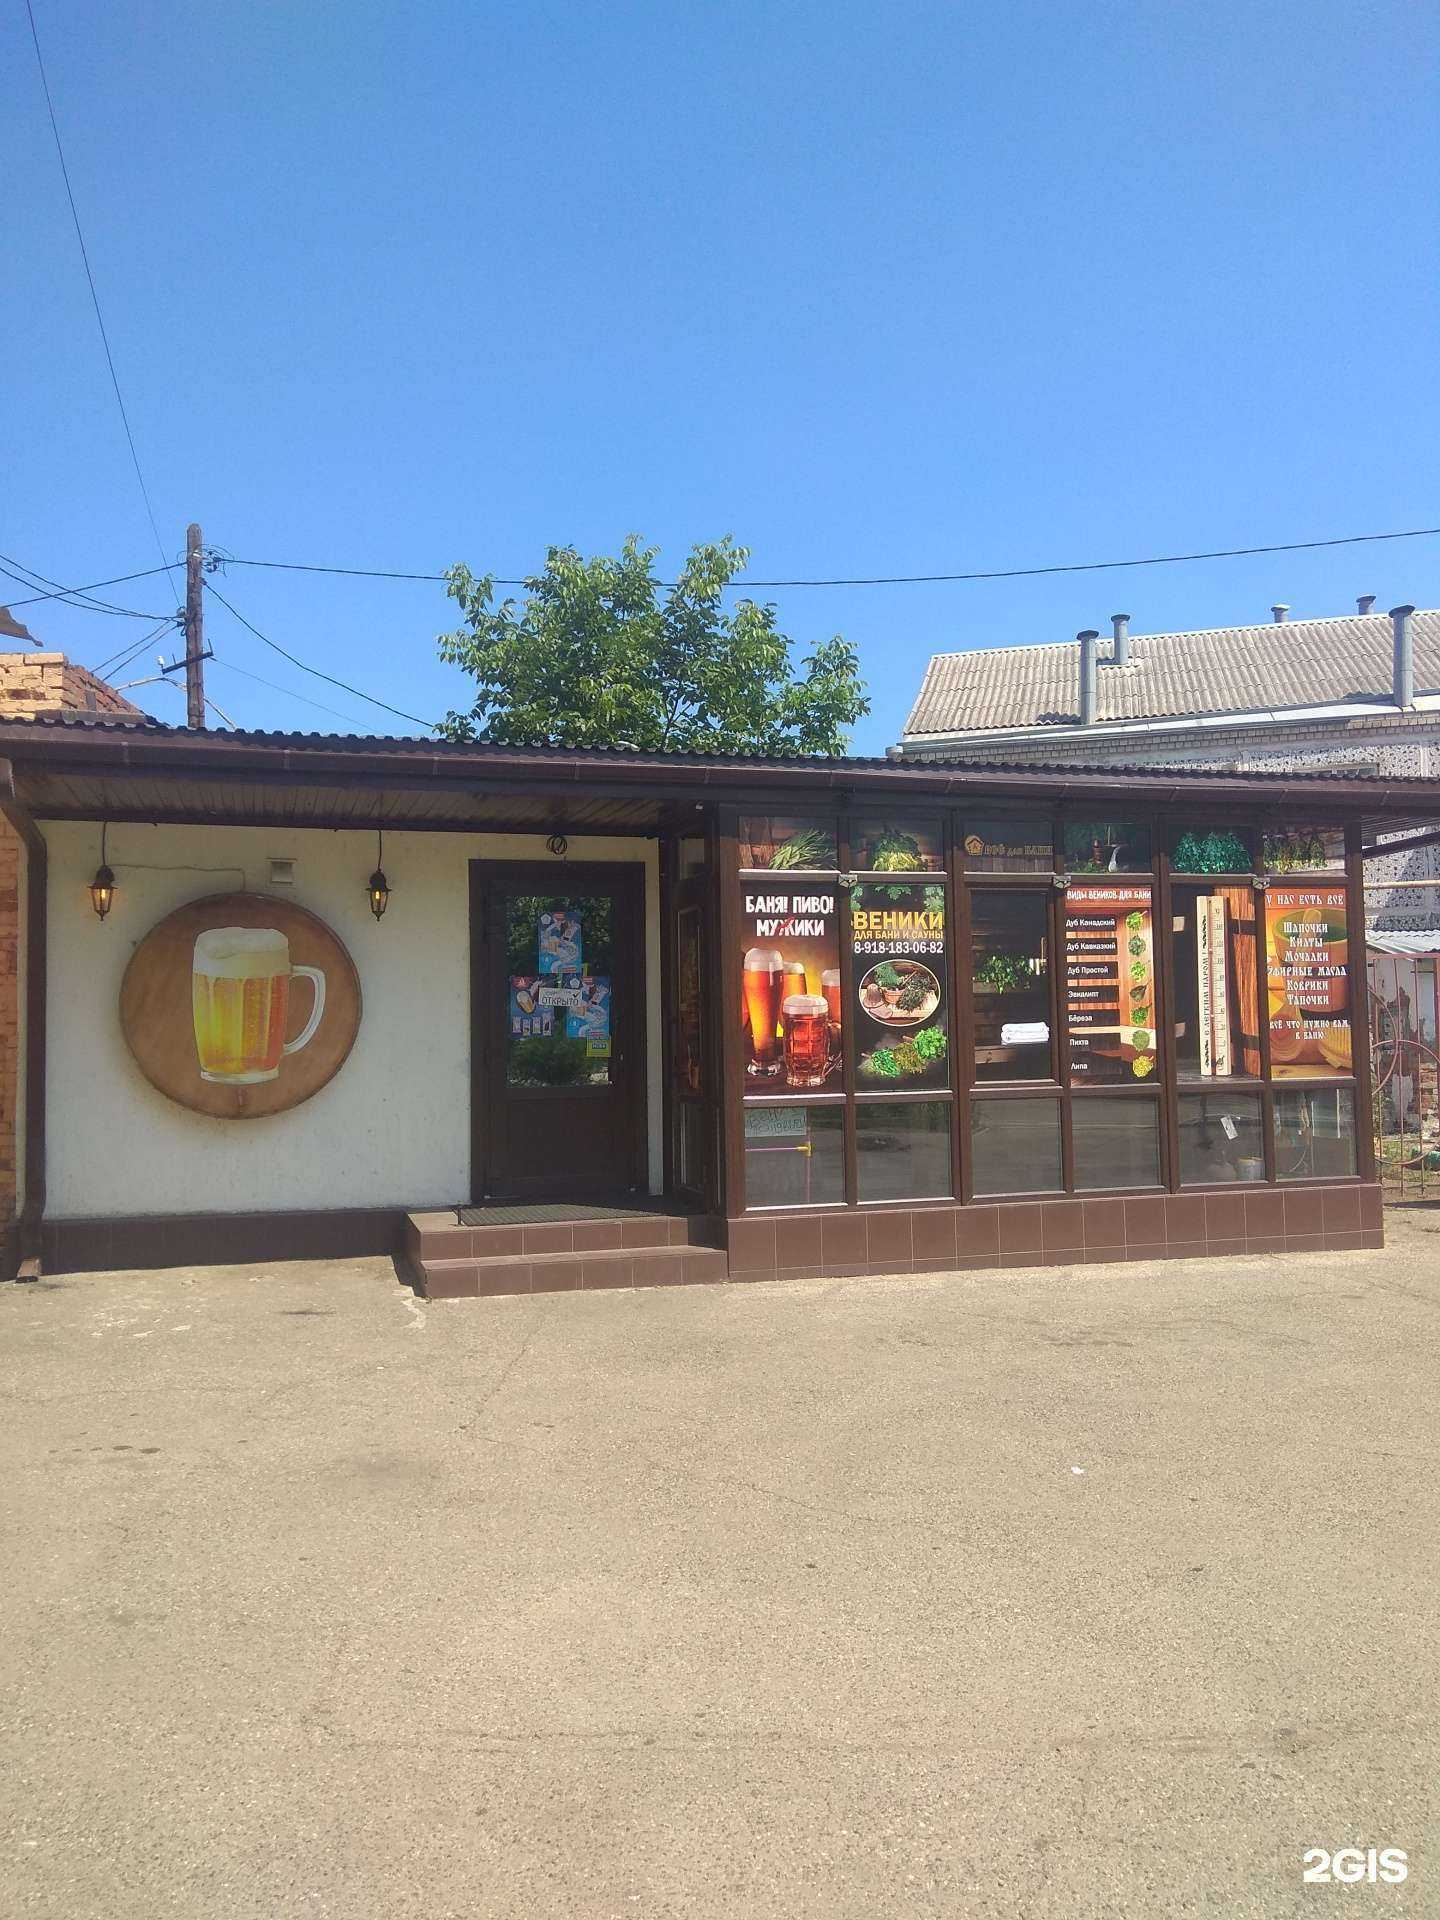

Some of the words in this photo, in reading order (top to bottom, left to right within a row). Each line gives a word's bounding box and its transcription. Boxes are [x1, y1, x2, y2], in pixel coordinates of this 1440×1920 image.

[1066, 890, 1087, 900] ВИДЫ
[1088, 890, 1117, 900] ВЕНИКОВ
[1119, 890, 1132, 901] ДЛЯ
[1133, 890, 1152, 900] БАНИ
[1277, 894, 1294, 904] НАС
[1299, 894, 1323, 904] ЕСТЬ
[1327, 893, 1344, 904] ВСЁ
[745, 896, 788, 913] БАНЯ!
[792, 896, 834, 914] ПИВО!
[853, 911, 943, 930] ВЕНИКИ
[1066, 918, 1078, 928] Дуб
[1079, 918, 1116, 927] Канадский
[854, 930, 873, 941] ДЛЯ
[875, 930, 900, 939] БАНИ
[902, 930, 909, 939] И
[911, 930, 943, 939] САУНЫ
[853, 941, 944, 954] 8-918-183-06-82
[1067, 943, 1079, 951] Дуб
[1067, 966, 1080, 975] Дуб
[1081, 966, 1109, 975] Простой
[542, 996, 579, 1006] ОТКРЫТО
[1286, 1020, 1301, 1029] ЧТО
[1069, 1038, 1089, 1046] Пихта
[1070, 1062, 1088, 1070] Липа
